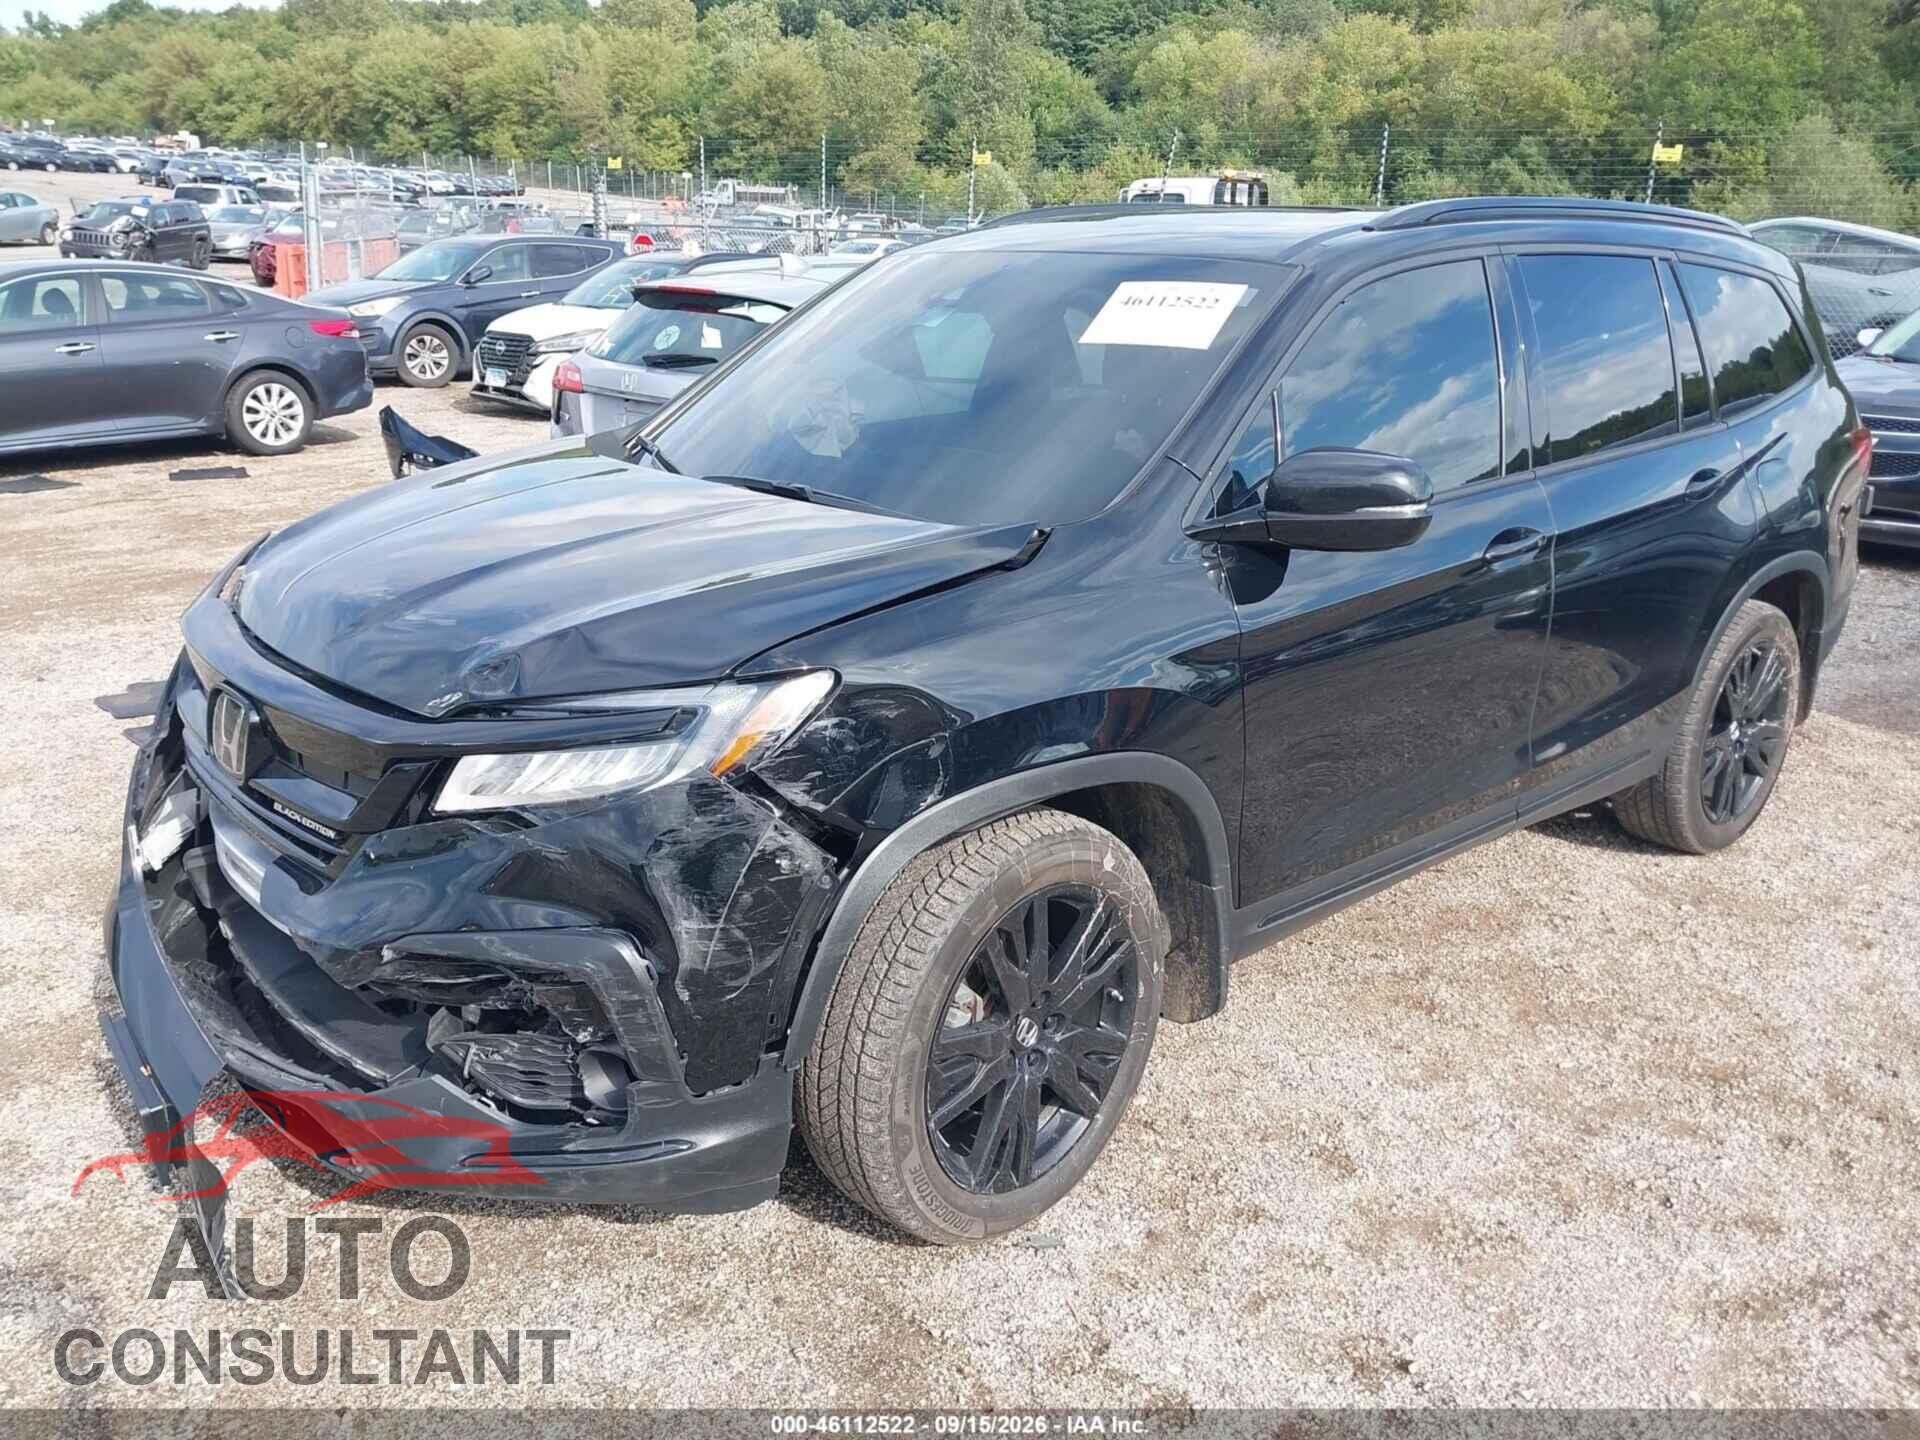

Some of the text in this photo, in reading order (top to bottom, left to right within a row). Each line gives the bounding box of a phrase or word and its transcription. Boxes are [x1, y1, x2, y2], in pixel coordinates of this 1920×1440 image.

[1120, 296, 1220, 309] 46112522
[273, 802, 336, 839] BLACK EDITION
[909, 1163, 973, 1234] BRIDGESTONE
